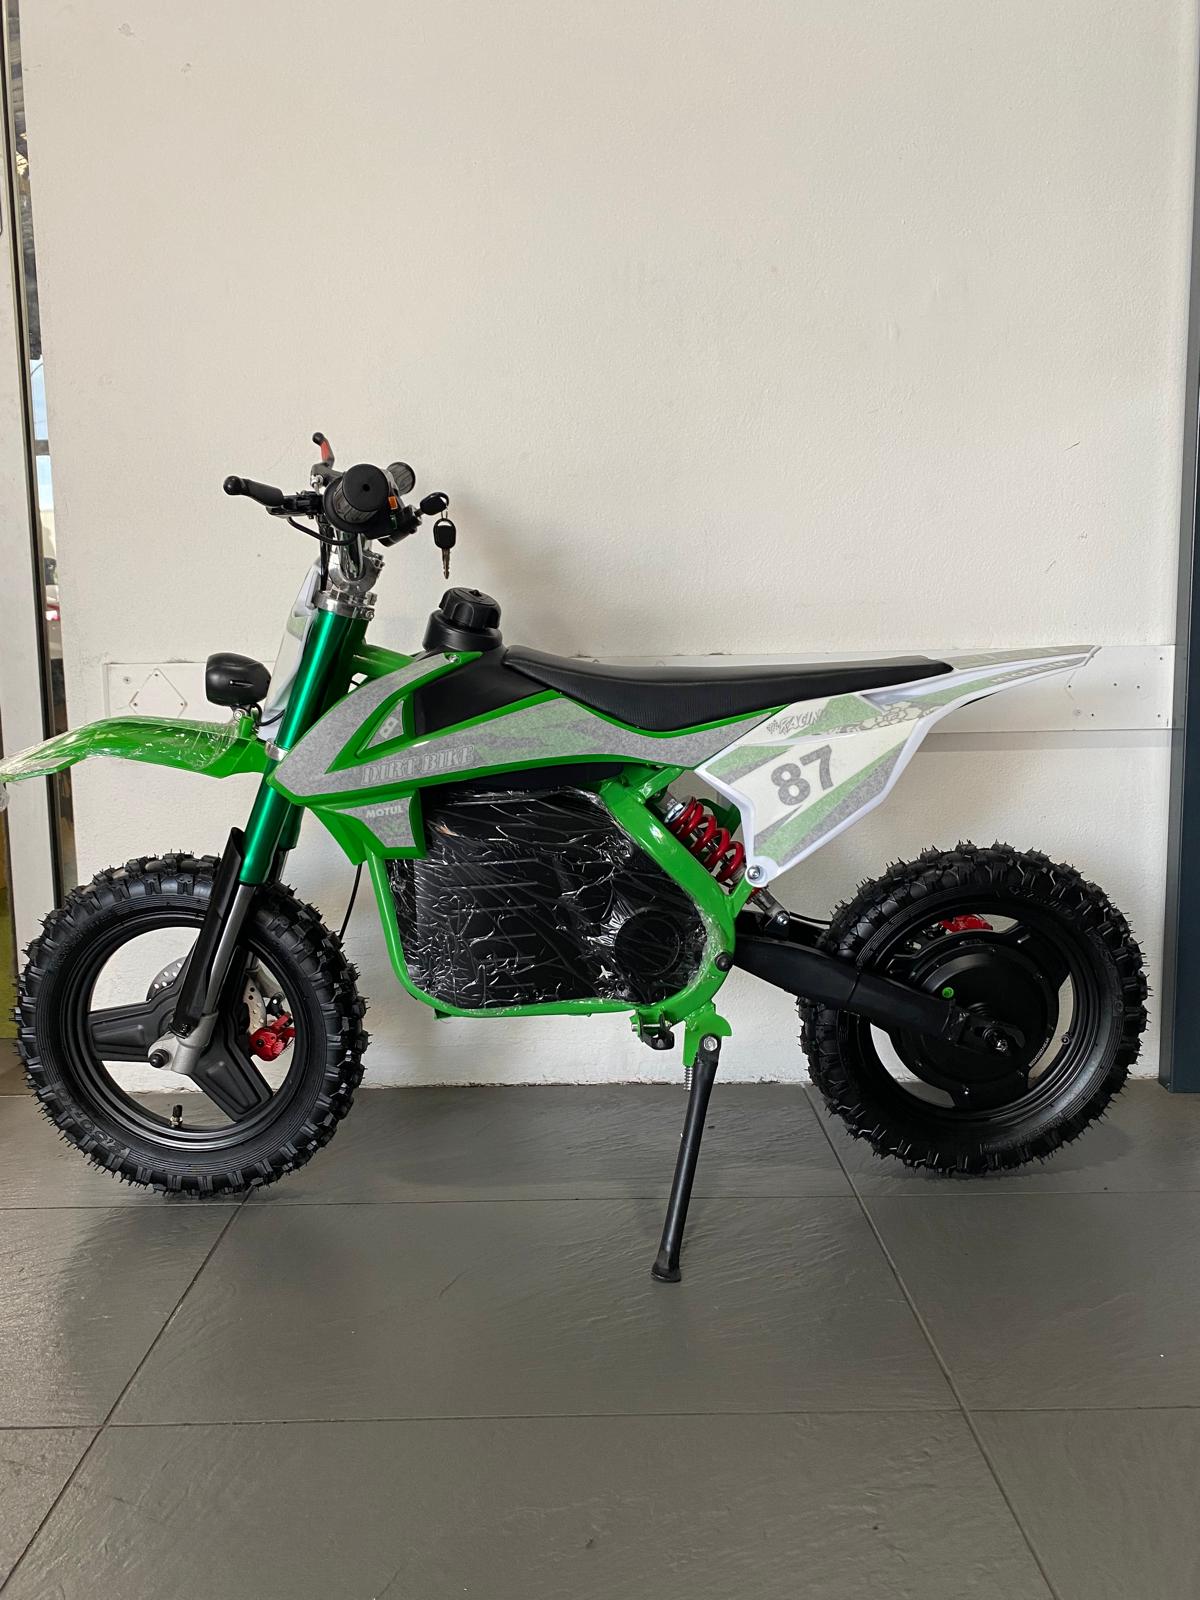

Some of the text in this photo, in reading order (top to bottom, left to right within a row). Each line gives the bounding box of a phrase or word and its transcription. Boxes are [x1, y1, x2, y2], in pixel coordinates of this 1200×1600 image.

[361, 745, 475, 785] DIRT BIKE
[771, 744, 833, 806] 87
